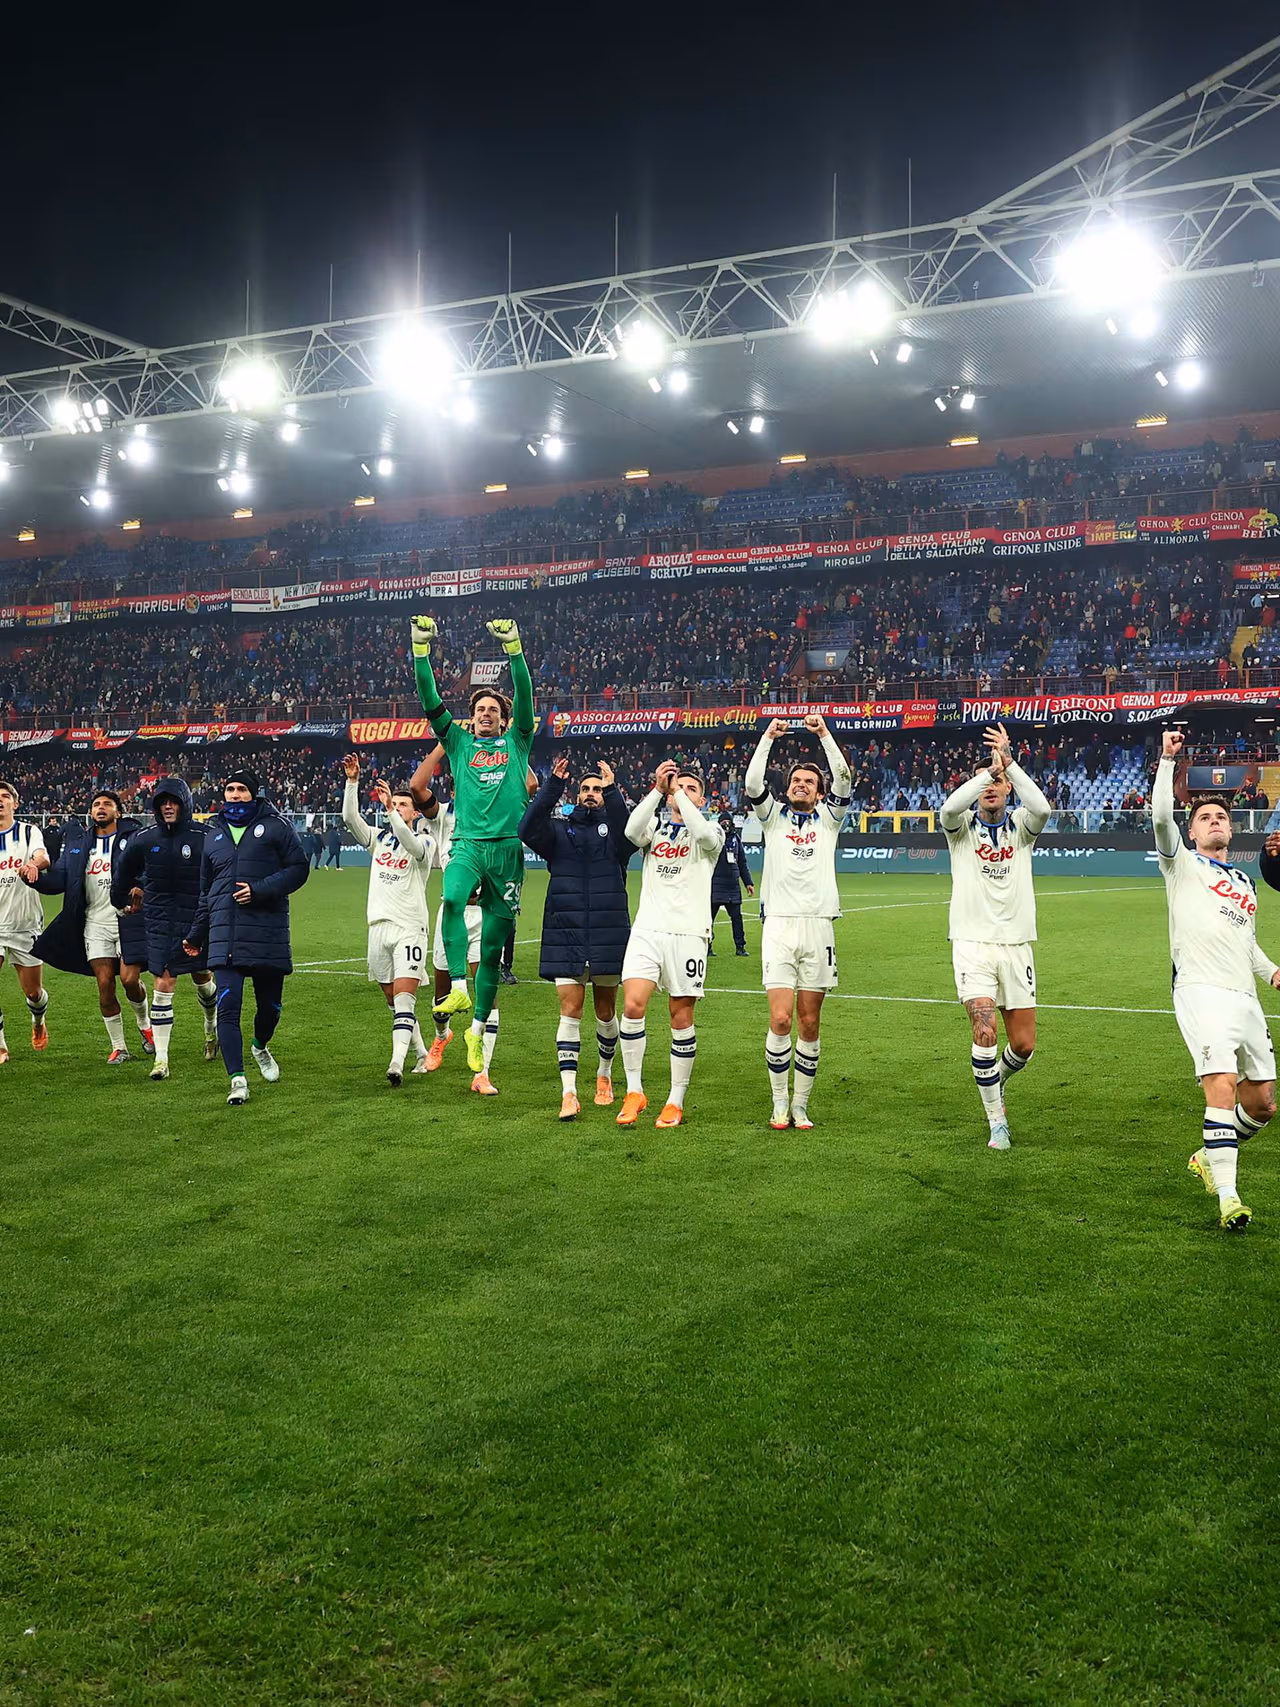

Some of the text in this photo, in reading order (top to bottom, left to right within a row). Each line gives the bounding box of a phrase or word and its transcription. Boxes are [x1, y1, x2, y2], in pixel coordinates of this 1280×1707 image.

[1140, 518, 1208, 528] GENOA CLU
[1210, 512, 1245, 521] GENOA
[898, 531, 971, 544] GENOA CLUB
[1003, 526, 1076, 542] GENOA CLUB
[1091, 530, 1137, 541] IMPERIA
[1154, 535, 1199, 544] ALIMONDA
[750, 543, 810, 555] GENOA CLUB
[816, 539, 883, 554] GENOA CLUB
[894, 537, 987, 552] ISTITUTO ITALIANO
[992, 537, 1082, 555] GRIFONE INSIDE
[648, 552, 748, 567] ARQUAT GENOA CLUB
[890, 546, 985, 561] DELLA SALDATURA
[824, 555, 872, 567] MIROGLIO
[510, 567, 529, 575] CLUB
[598, 566, 641, 579] EUSEBIO
[696, 565, 747, 574] ENTRACQUE
[379, 576, 431, 589] GENOA CLUB
[432, 573, 456, 581] GENOA
[548, 572, 588, 587] LIGURIA
[233, 583, 319, 599] GENOA CLUB NEW YORK
[321, 579, 369, 592] GENOA CLUB
[435, 587, 453, 595] PRA
[486, 580, 528, 591] REGIONE
[200, 591, 232, 602] COMPAGNI
[320, 591, 368, 603] SAN TEODORO
[379, 591, 413, 601] RAPALLO
[207, 602, 228, 611] UNICA
[1, 608, 15, 619] QUI
[92, 611, 119, 620] CASOTTO
[475, 664, 503, 675] CICC
[1122, 693, 1188, 707] GENOA CLUB
[1194, 693, 1240, 702] GENOA
[761, 705, 830, 715] GENOA CLUB GAVI
[832, 704, 903, 715] GENOA CLUB
[911, 702, 957, 711] GENOA CLUB
[1050, 697, 1117, 713] GRIFONI
[574, 711, 659, 723] ASSOCIAZIONE
[681, 709, 758, 729] Little Club
[1051, 711, 1113, 725] TORINO
[570, 722, 653, 734] CLUB GENOANI
[835, 719, 897, 730] VALBORMIDA
[9, 730, 31, 741] GENOA
[350, 720, 398, 743] FIGGI
[469, 749, 509, 768] Lete
[651, 841, 690, 859] Lete
[975, 843, 1014, 863] Lete
[0, 855, 23, 870] ete
[86, 858, 111, 875] Le
[375, 851, 409, 870] Lete
[1208, 880, 1257, 916] Lete
[405, 945, 422, 962] 10
[825, 946, 837, 966] 1
[685, 959, 705, 978] 90
